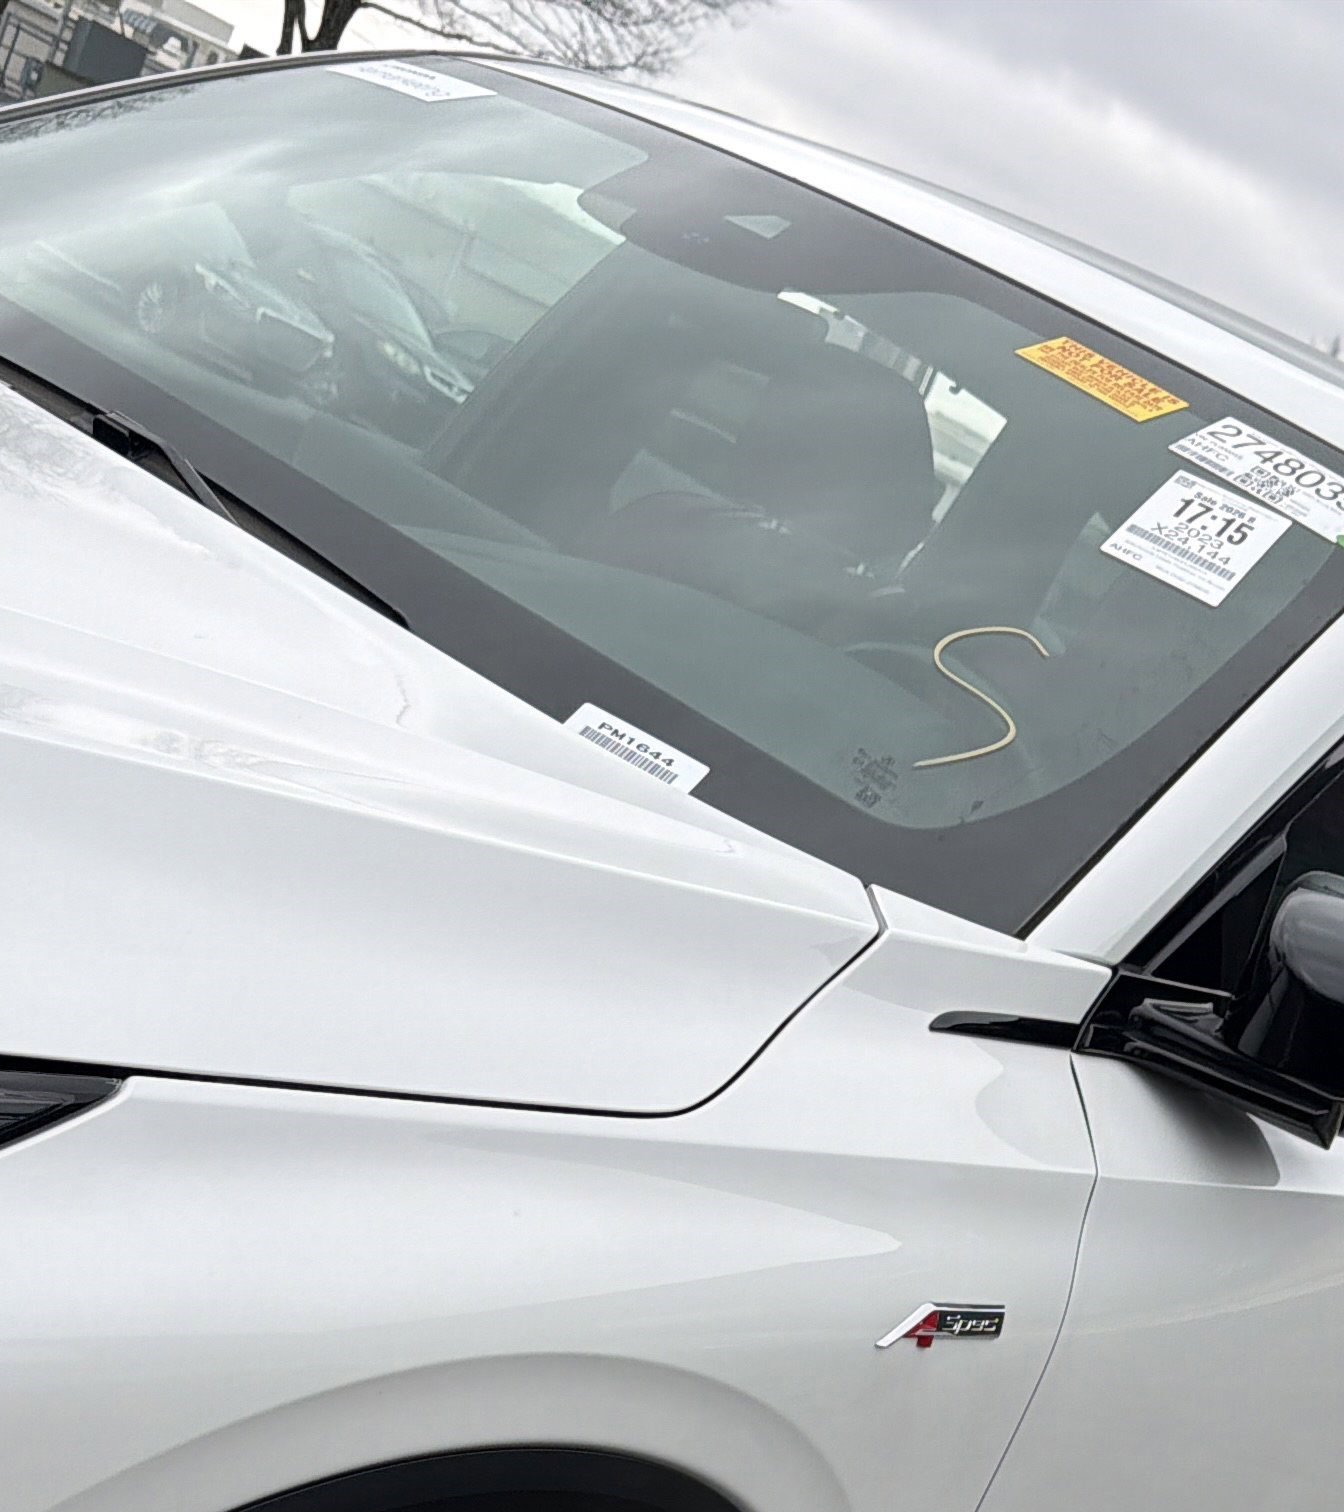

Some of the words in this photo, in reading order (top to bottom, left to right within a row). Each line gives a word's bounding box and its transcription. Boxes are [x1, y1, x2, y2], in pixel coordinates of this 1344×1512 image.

[1188, 438, 1229, 462] AHFC
[1173, 498, 1255, 546] 17:15
[1174, 522, 1225, 550] 2023
[1109, 542, 1143, 561] AHFC
[1151, 522, 1232, 566] X24,144
[597, 720, 675, 767] PM1644
